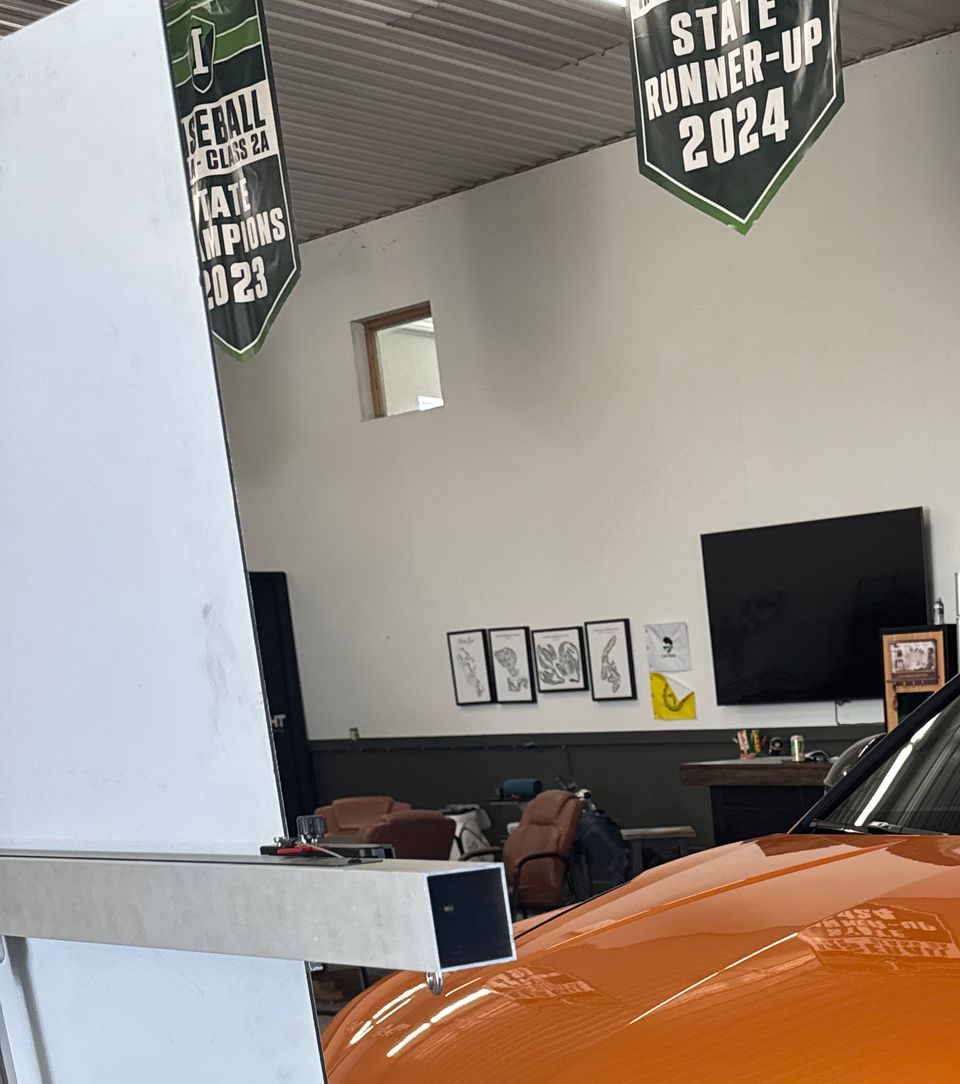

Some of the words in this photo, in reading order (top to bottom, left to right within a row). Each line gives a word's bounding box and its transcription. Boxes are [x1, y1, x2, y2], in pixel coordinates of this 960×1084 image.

[670, 0, 777, 57] STATE
[644, 17, 823, 121] RUNNER-UP
[205, 138, 248, 170] CLASS
[250, 130, 270, 156] 2A
[678, 86, 790, 172] 2024
[193, 177, 251, 222] TATE
